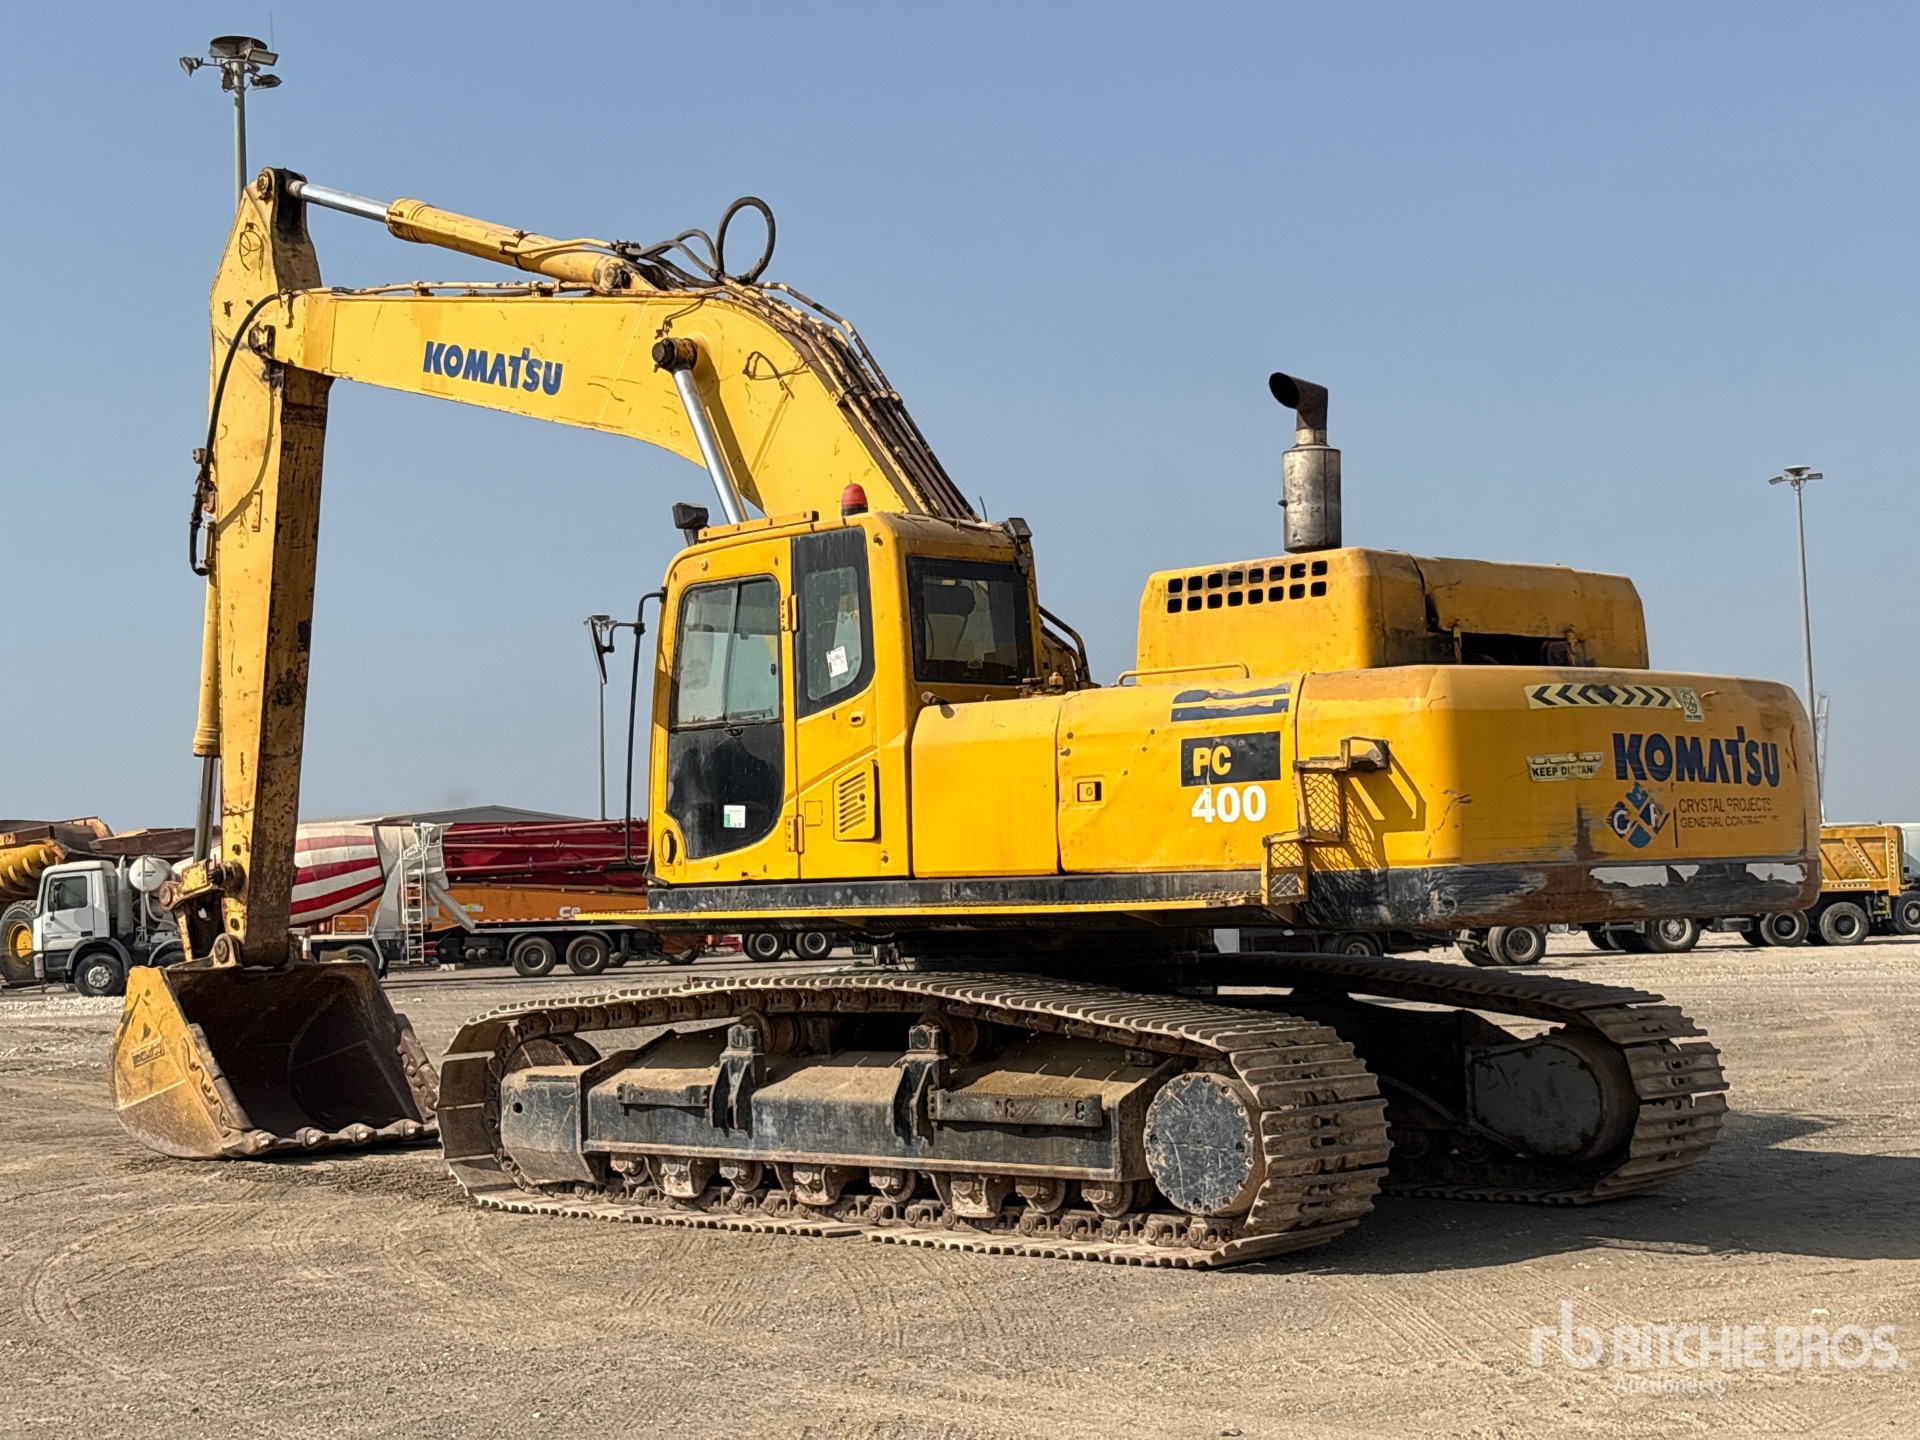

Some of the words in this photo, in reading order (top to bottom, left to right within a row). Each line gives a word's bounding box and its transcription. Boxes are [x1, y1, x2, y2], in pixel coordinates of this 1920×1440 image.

[423, 341, 563, 396] KOMATSU
[1193, 745, 1232, 777] PC
[1532, 766, 1558, 777] KEEP
[1612, 726, 1780, 788] KOMATSU
[1191, 785, 1267, 823] 400
[1679, 798, 1725, 813] CRYSTAL
[1726, 797, 1772, 812] PROJECTS
[1680, 816, 1724, 828] GENERAL
